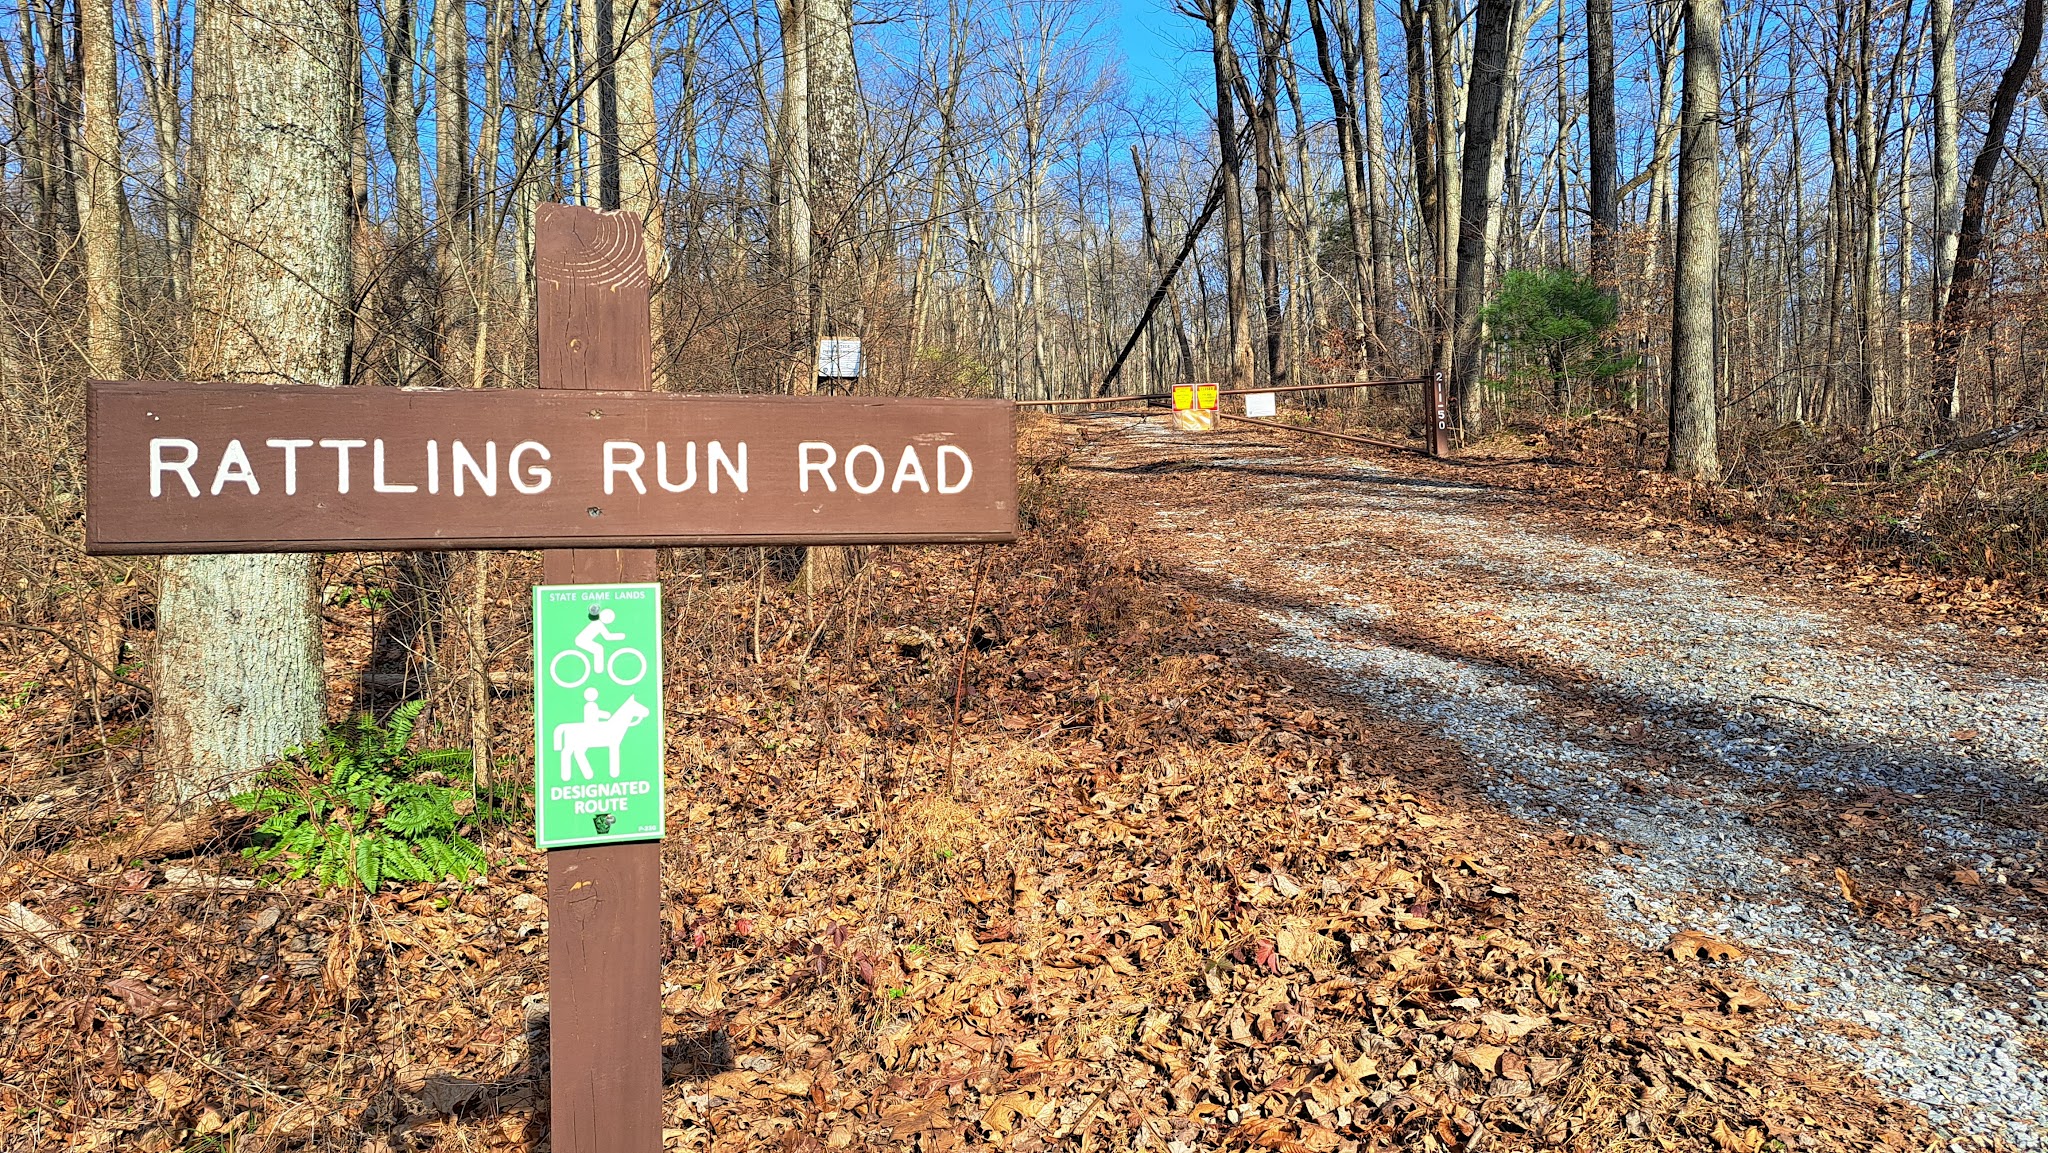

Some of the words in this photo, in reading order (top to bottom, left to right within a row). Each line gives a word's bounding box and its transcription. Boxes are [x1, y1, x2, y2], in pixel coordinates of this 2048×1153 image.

[149, 438, 552, 498] RATTLING
[603, 440, 749, 496] RUN
[798, 442, 974, 495] ROAD
[549, 592, 577, 601] STATE
[581, 591, 610, 601] GAME
[614, 590, 646, 600] LANDS
[551, 781, 650, 800] DESIGNATED
[575, 798, 627, 814] ROUTE
